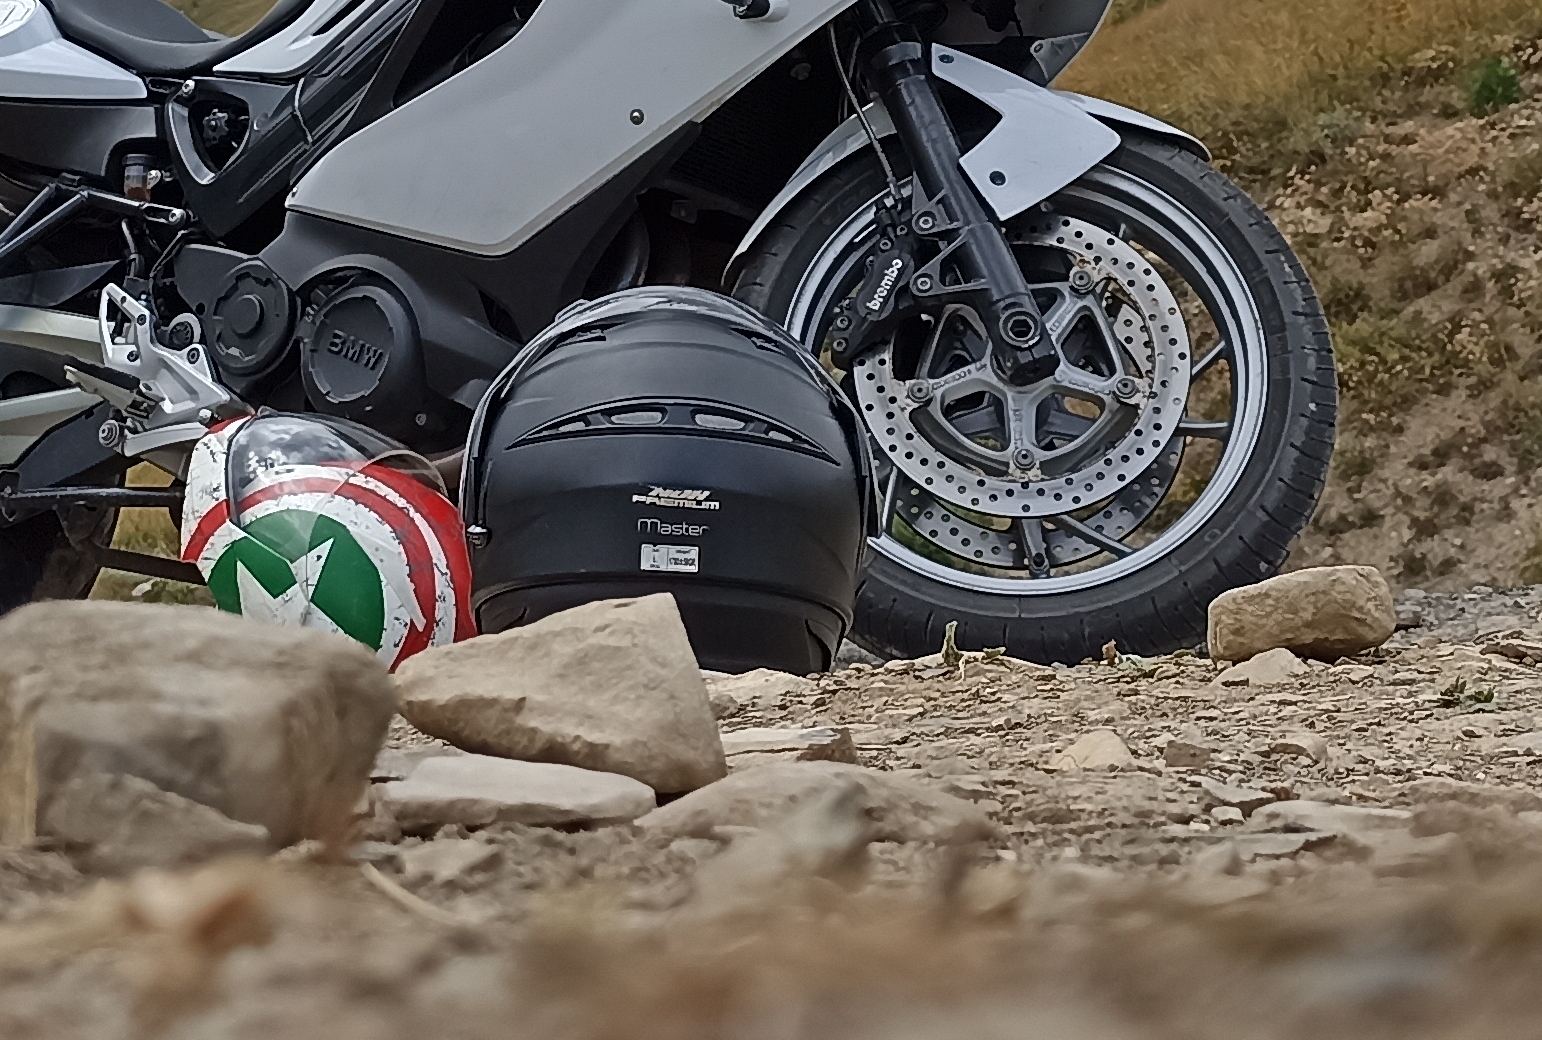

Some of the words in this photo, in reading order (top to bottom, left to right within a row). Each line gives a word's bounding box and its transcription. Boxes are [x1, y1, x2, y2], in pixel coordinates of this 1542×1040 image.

[866, 259, 903, 311] brembo
[327, 329, 384, 371] BMW
[638, 518, 710, 536] Master
